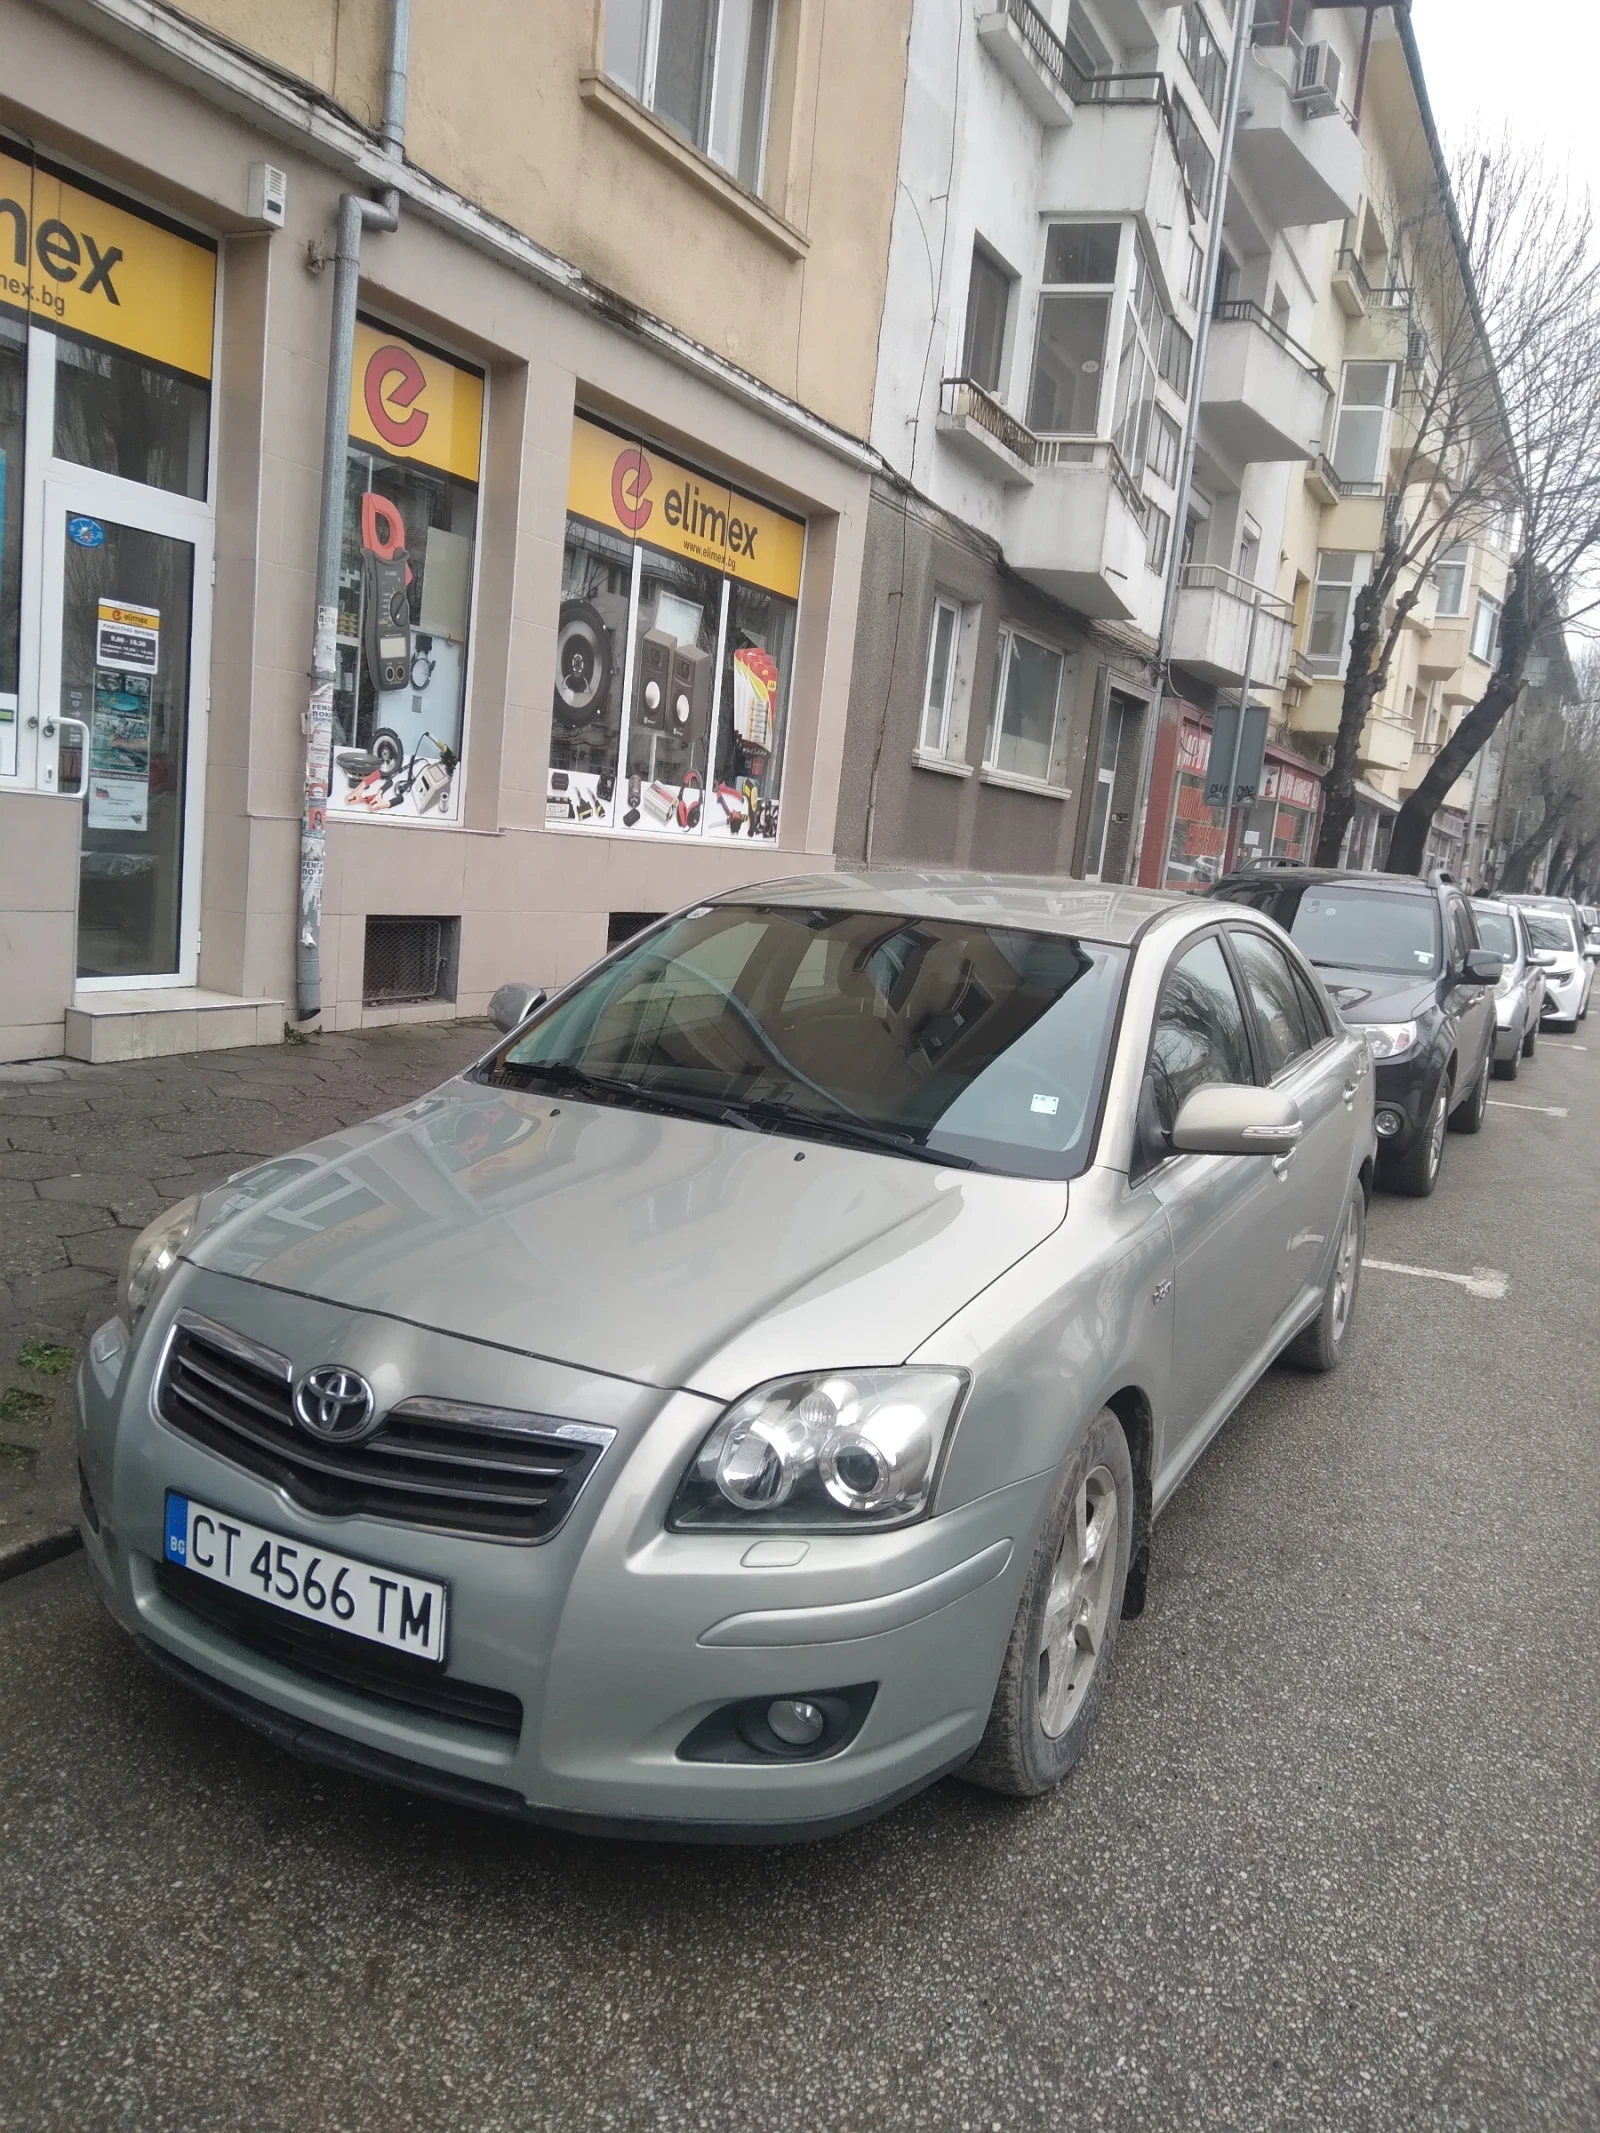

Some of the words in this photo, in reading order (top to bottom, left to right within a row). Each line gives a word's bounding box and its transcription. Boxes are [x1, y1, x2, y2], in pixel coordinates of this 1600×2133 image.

[664, 482, 758, 560] elimex
[683, 540, 736, 572] www.elimex.bg
[103, 623, 133, 633] РАБОТНО
[134, 629, 155, 638] ВРЕМЕ
[124, 613, 148, 624] elimex
[170, 1535, 186, 1555] BG
[192, 1514, 241, 1577] CT
[250, 1540, 355, 1620] 4566
[369, 1575, 432, 1648] TM
